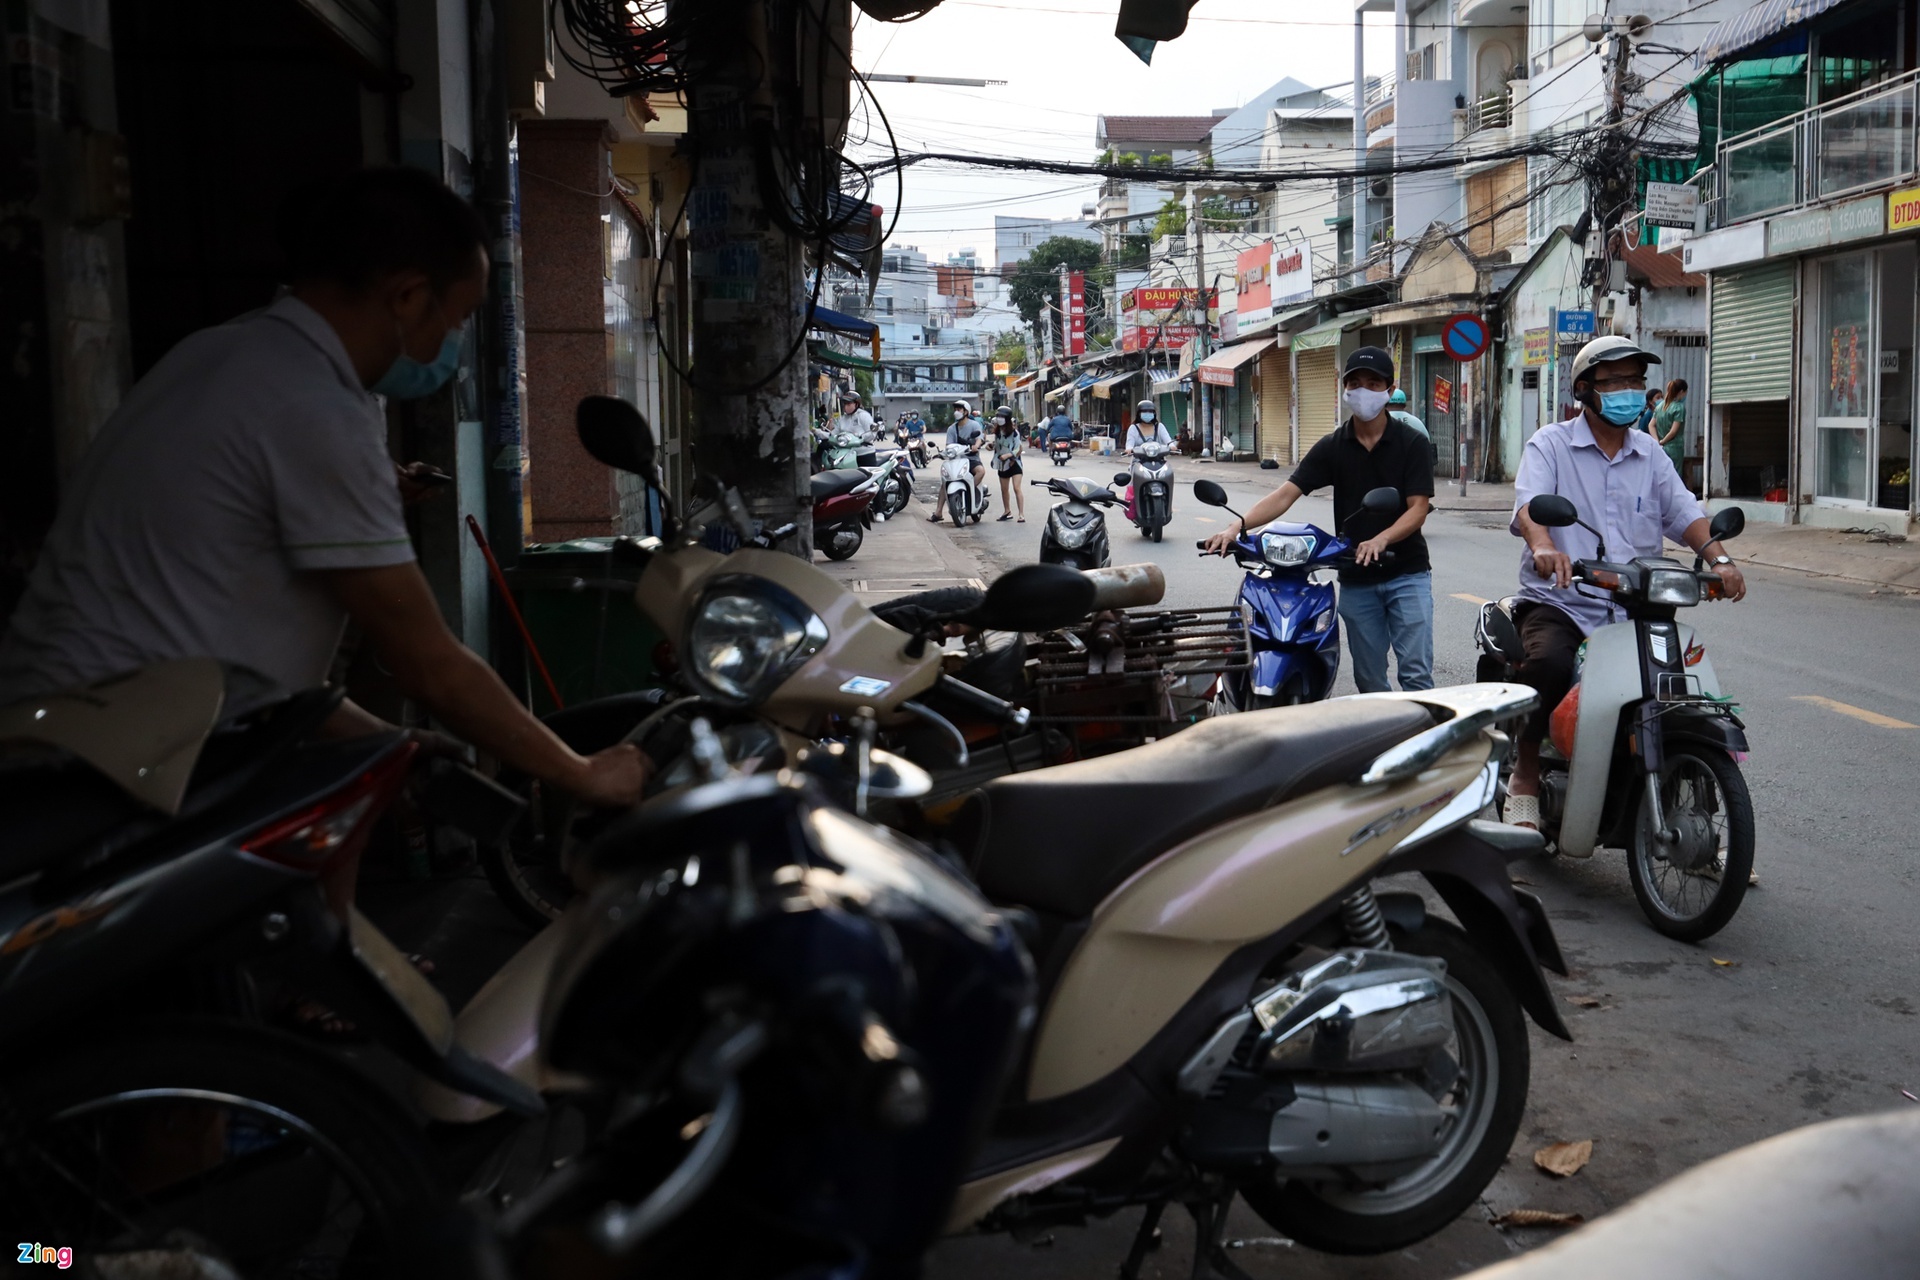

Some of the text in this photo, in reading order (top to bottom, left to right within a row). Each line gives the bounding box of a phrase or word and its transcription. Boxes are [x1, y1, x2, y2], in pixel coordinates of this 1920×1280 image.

[1670, 186, 1692, 195] Beauty
[1145, 290, 1166, 301] ĐẬU
[1567, 320, 1584, 331] SỐ 4
